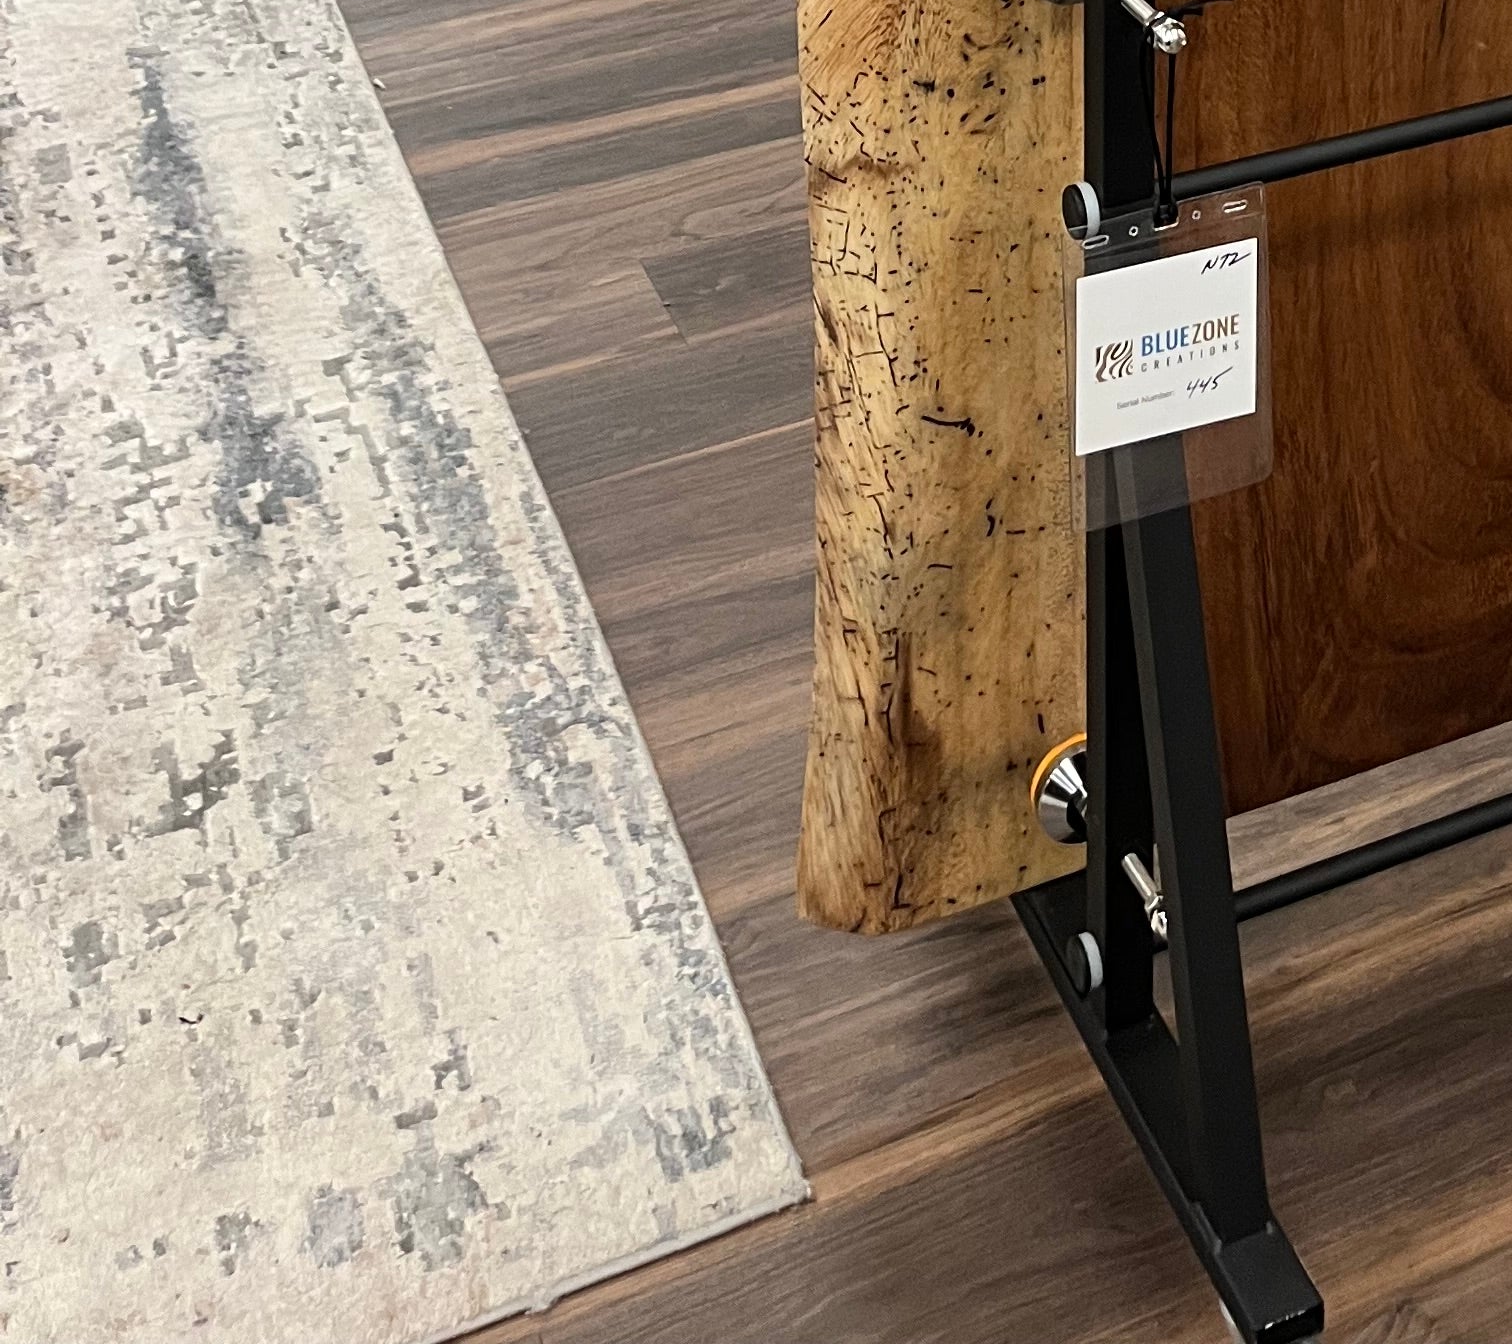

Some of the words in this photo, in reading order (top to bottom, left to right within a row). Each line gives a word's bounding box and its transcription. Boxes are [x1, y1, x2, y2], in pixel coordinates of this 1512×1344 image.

[1141, 314, 1240, 357] BLUEZONE
[1141, 340, 1240, 372] CREATIONS
[1187, 366, 1233, 398] 445
